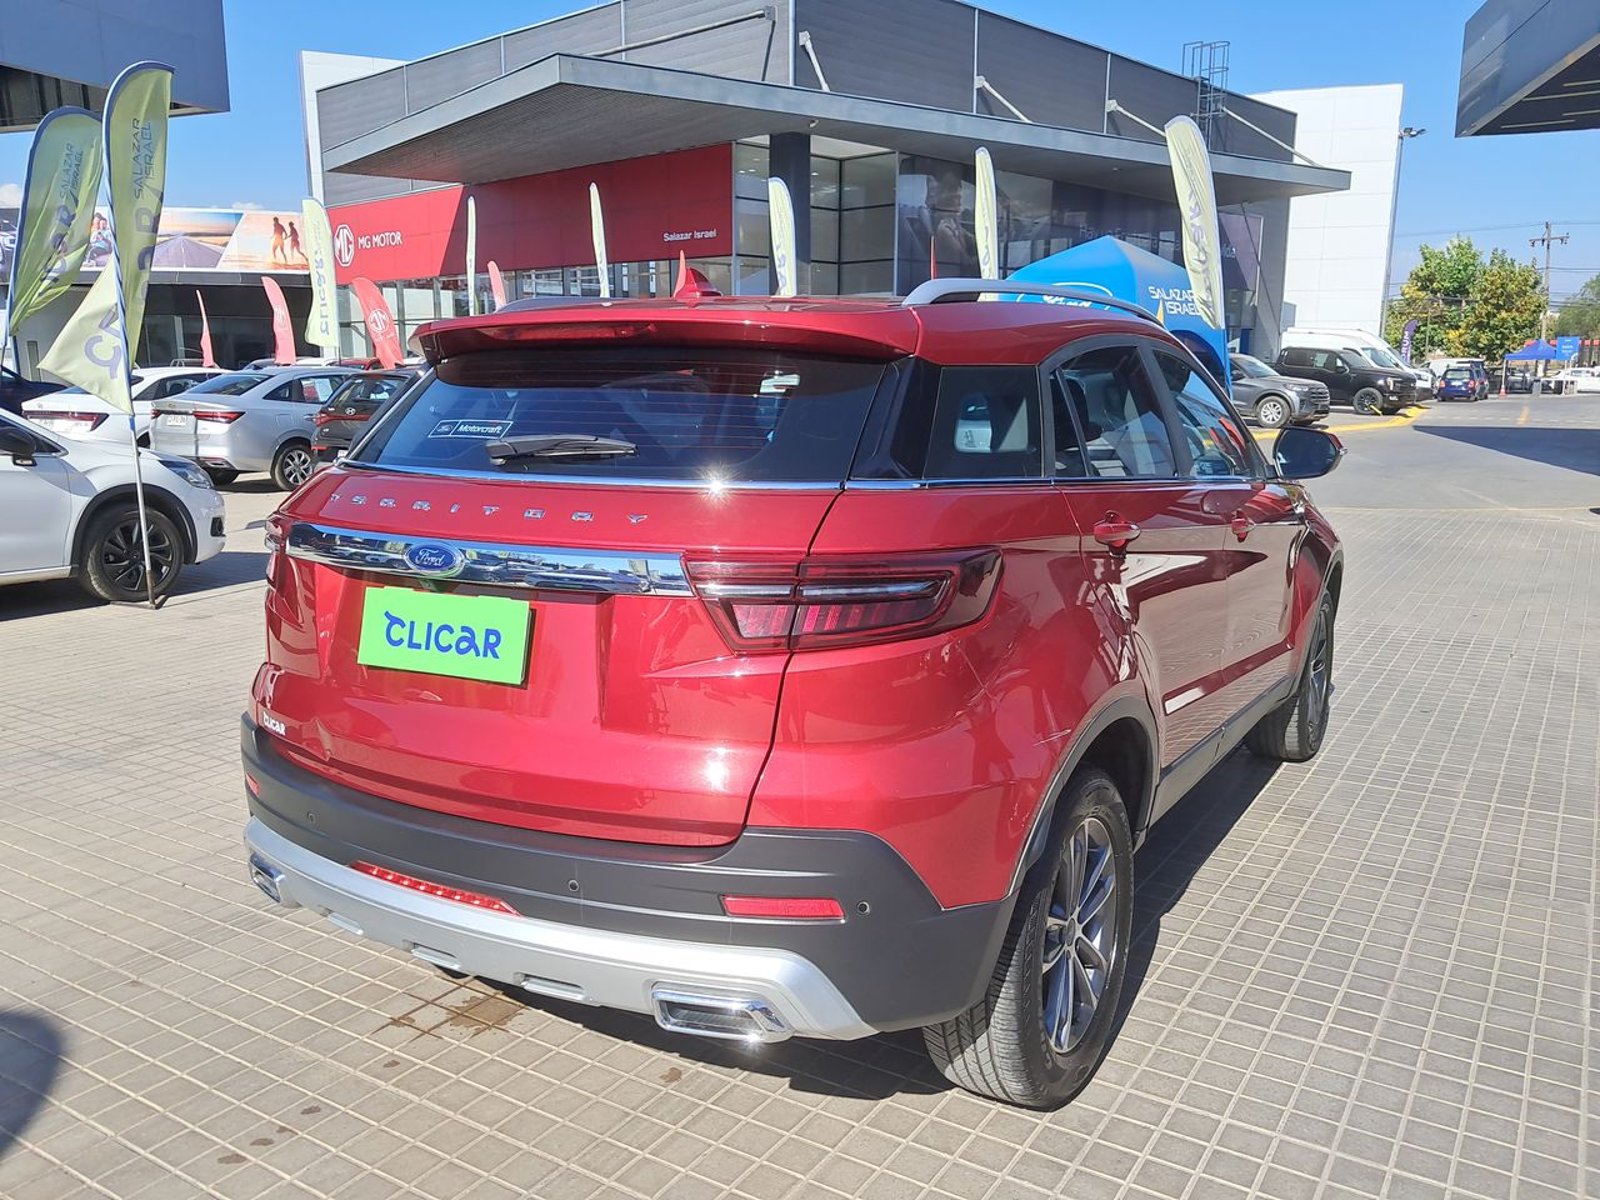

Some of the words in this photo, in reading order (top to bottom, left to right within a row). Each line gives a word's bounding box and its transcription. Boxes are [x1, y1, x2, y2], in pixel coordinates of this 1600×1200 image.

[132, 118, 144, 200] SALAZAR
[141, 121, 154, 180] ISRAEL
[60, 143, 74, 199] SALAZAR
[358, 235, 371, 249] MG
[372, 231, 403, 247] MOTOR
[663, 232, 692, 242] Salazar
[693, 229, 717, 239] Israel
[1148, 286, 1194, 302] SALAZAR
[1165, 301, 1201, 316] ISRAEL
[457, 424, 503, 434] Motorcraft
[414, 548, 446, 567] Ford
